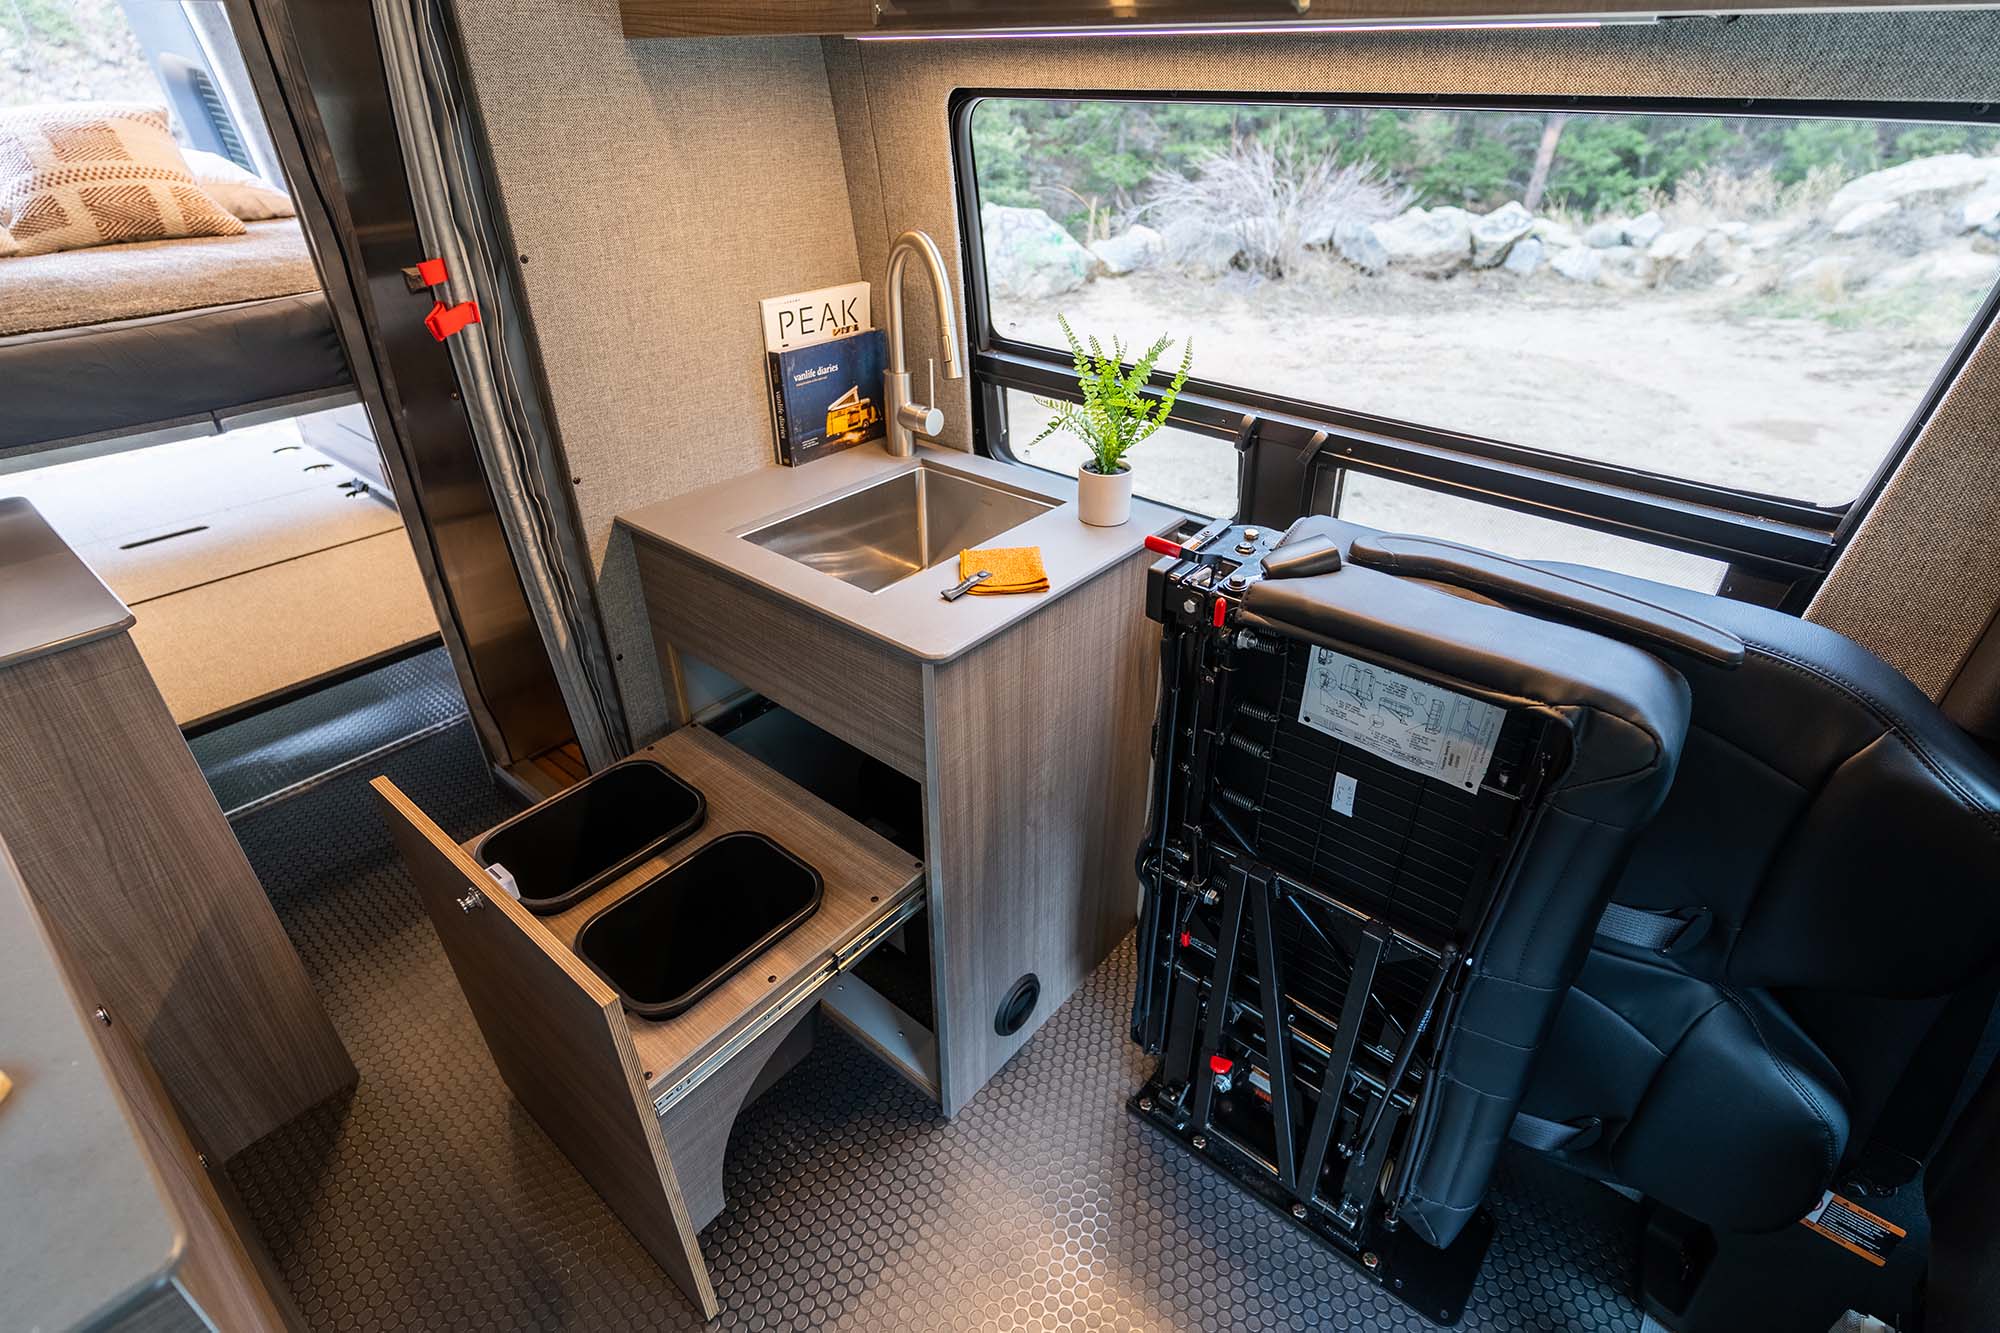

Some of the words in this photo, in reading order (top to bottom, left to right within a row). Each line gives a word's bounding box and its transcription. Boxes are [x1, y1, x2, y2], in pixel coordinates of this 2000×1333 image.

[779, 297, 859, 340] PEAK
[793, 368, 816, 382] vanlife
[817, 363, 839, 376] diaries
[775, 391, 784, 415] vanlife
[1858, 1208, 1891, 1229] WARNING
